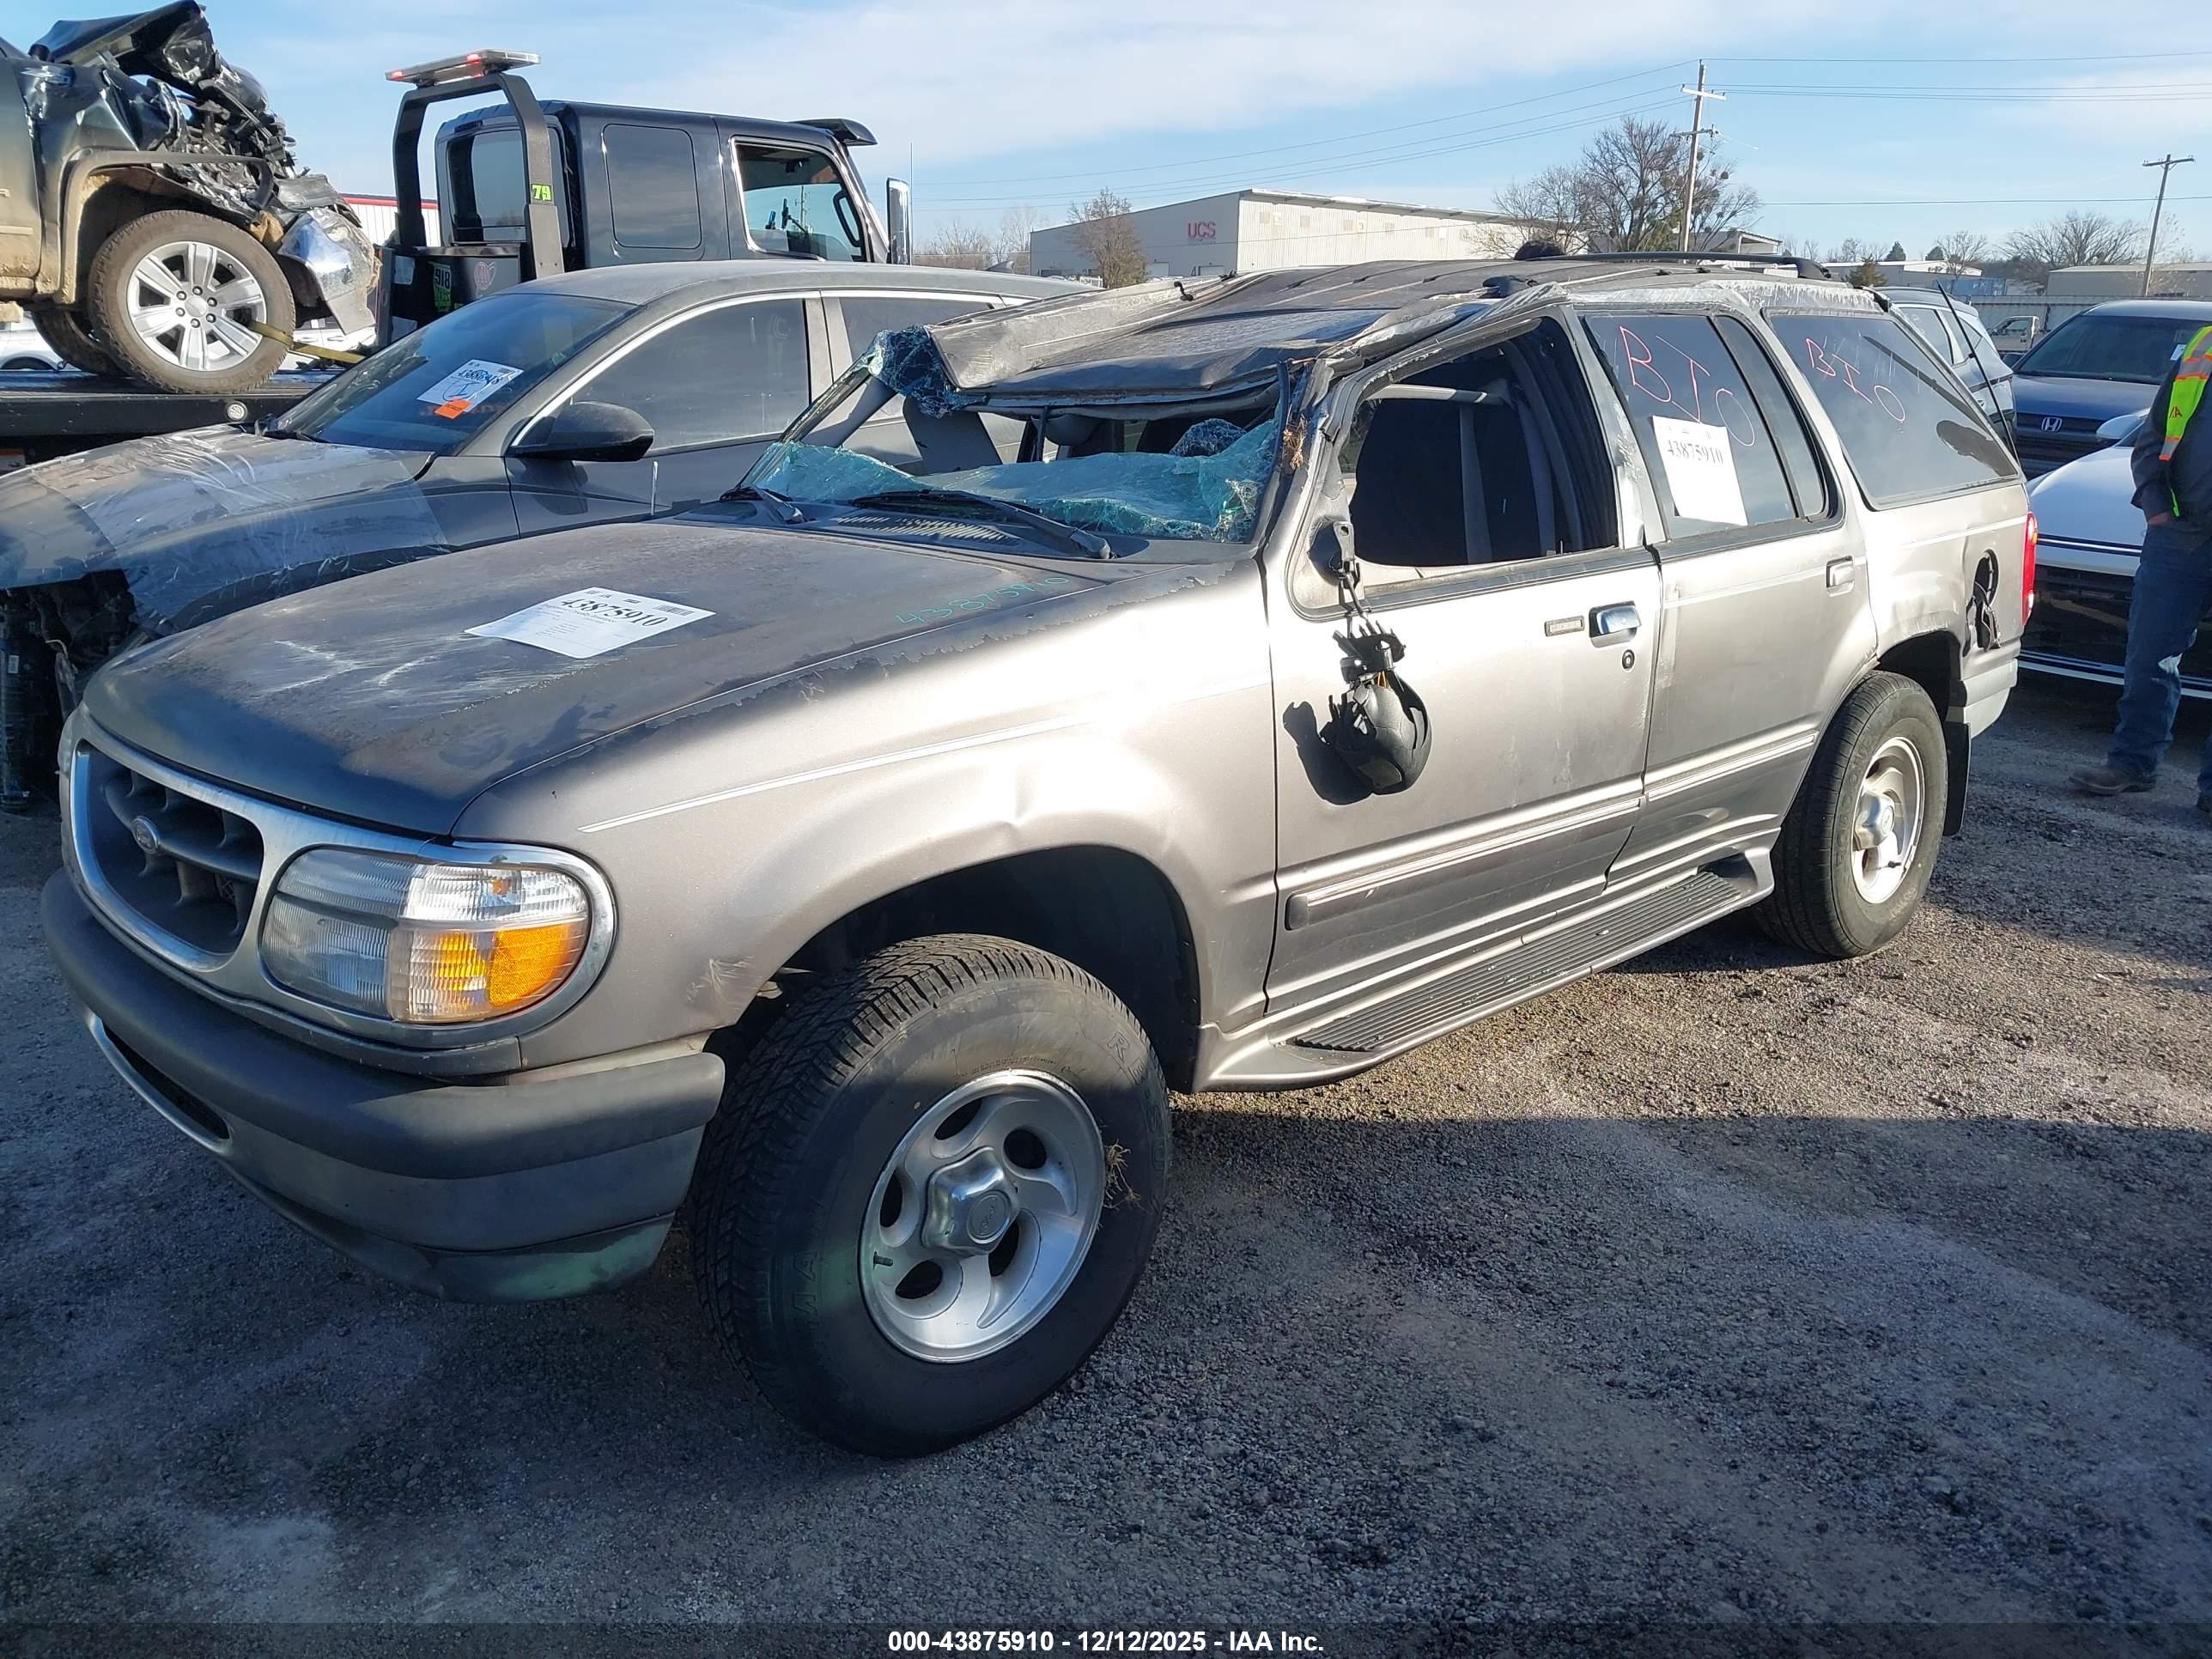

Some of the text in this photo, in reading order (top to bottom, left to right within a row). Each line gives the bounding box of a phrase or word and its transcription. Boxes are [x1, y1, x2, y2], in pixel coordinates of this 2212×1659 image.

[532, 184, 551, 201] 79
[1188, 221, 1216, 239] UCS
[435, 268, 451, 289] 918
[1805, 337, 1905, 422] BIO
[896, 576, 1070, 623] 43875910
[561, 599, 668, 626] 43875910
